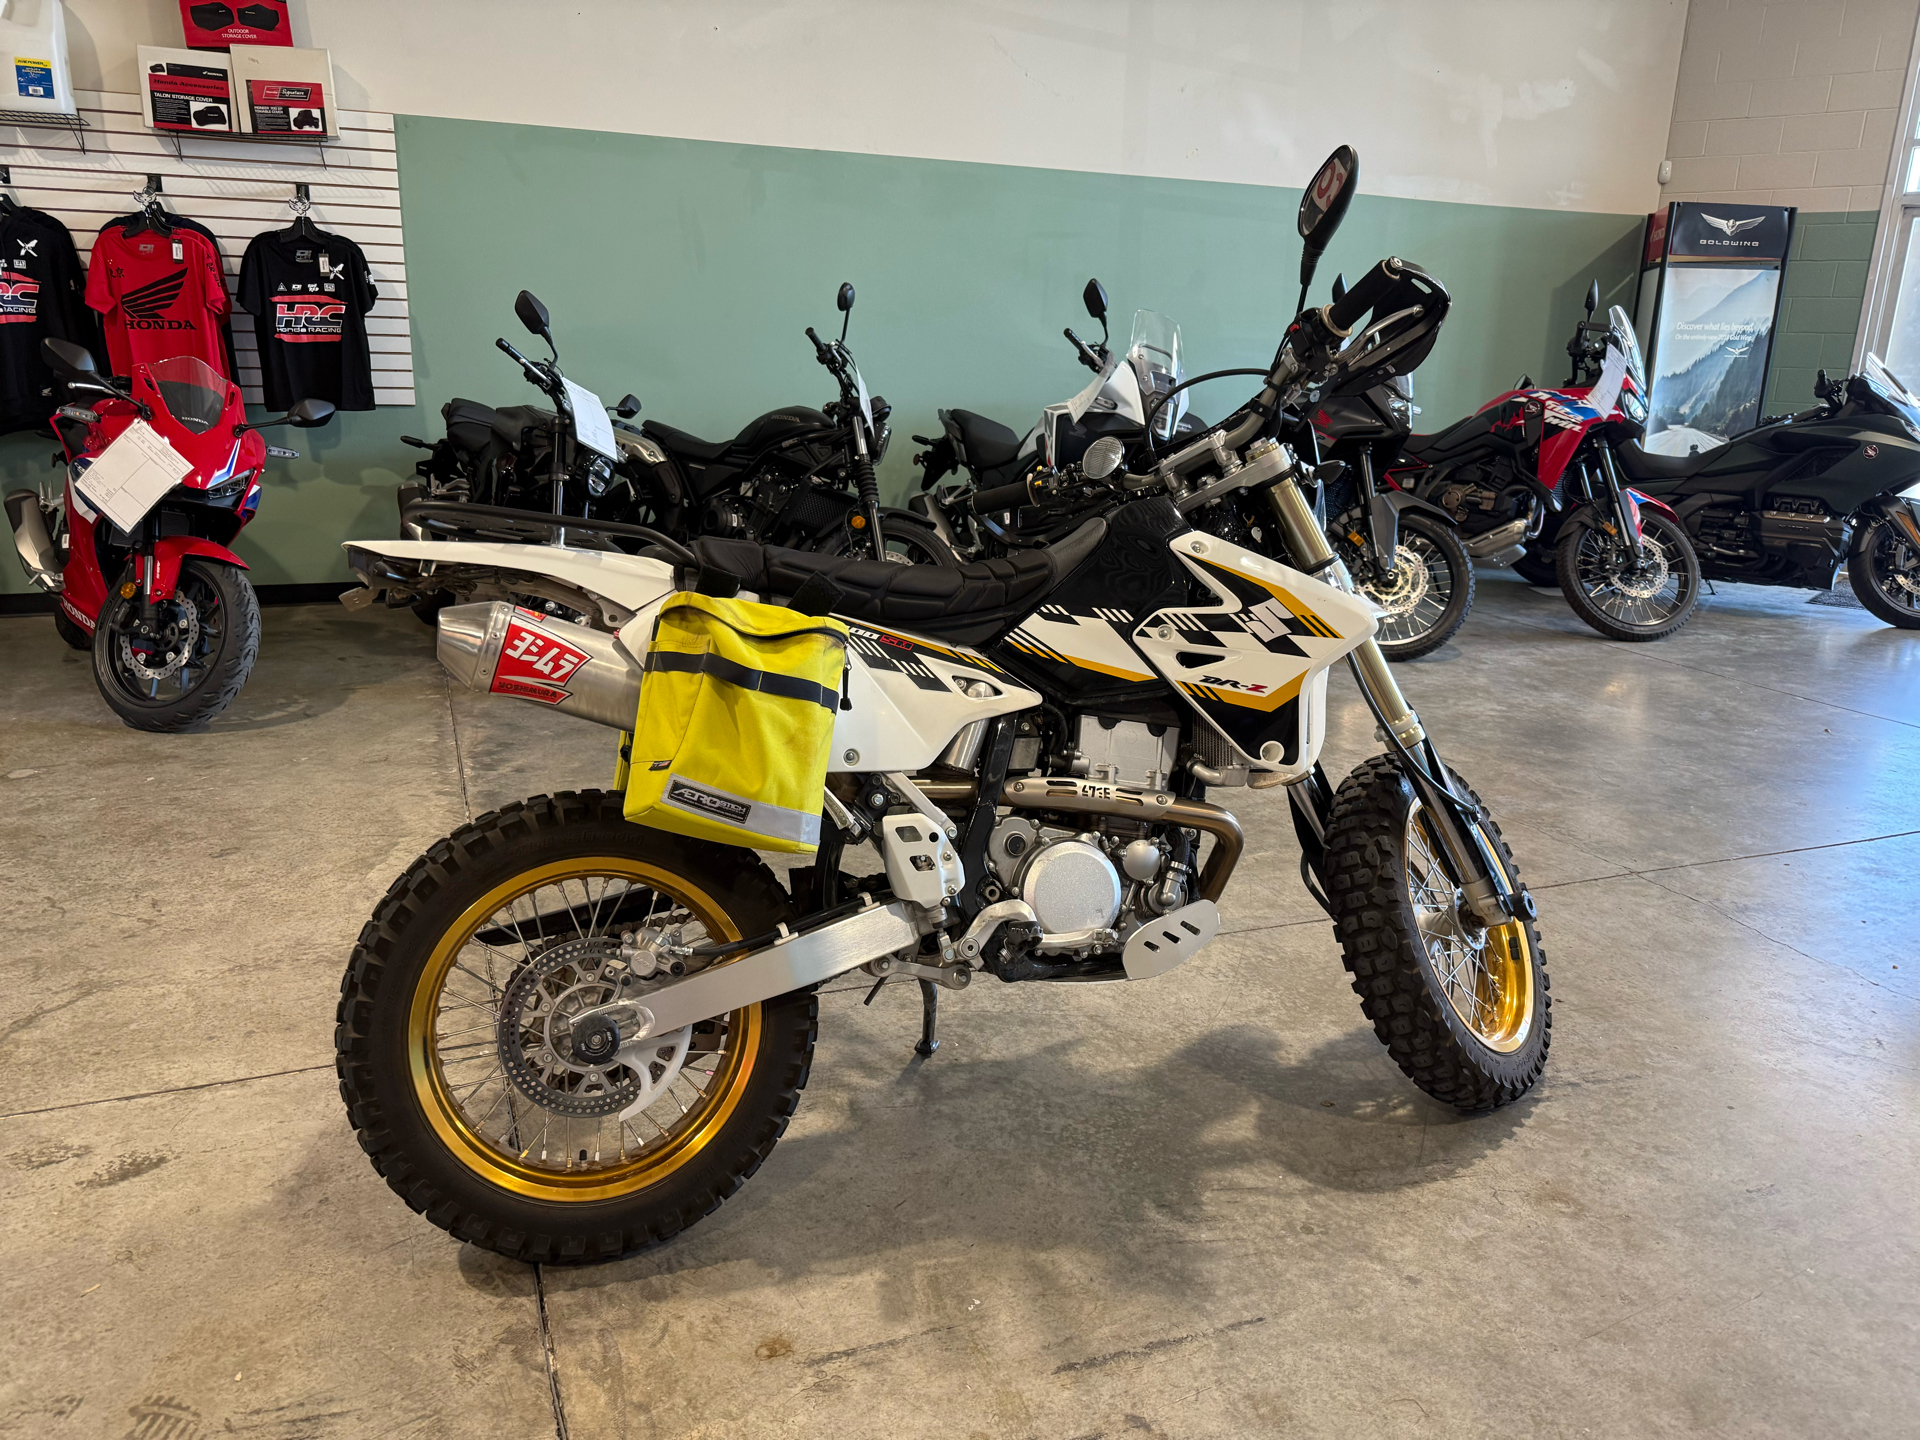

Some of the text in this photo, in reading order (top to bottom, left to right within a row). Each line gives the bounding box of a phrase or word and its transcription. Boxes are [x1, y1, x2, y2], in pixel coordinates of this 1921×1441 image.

[154, 78, 224, 91] Honda Accessories
[1700, 239, 1759, 247] GOLDWING
[276, 304, 346, 328] HRC
[124, 320, 198, 331] HONDA
[1677, 322, 1703, 330] Discover
[1704, 322, 1721, 331] what
[181, 416, 210, 426] HONDA
[770, 414, 801, 423] HONDA
[847, 625, 915, 652] 00 SM
[504, 630, 581, 680] ヨシムラ
[497, 681, 558, 698] YOSHIMURA
[1199, 674, 1269, 694] DR-Z
